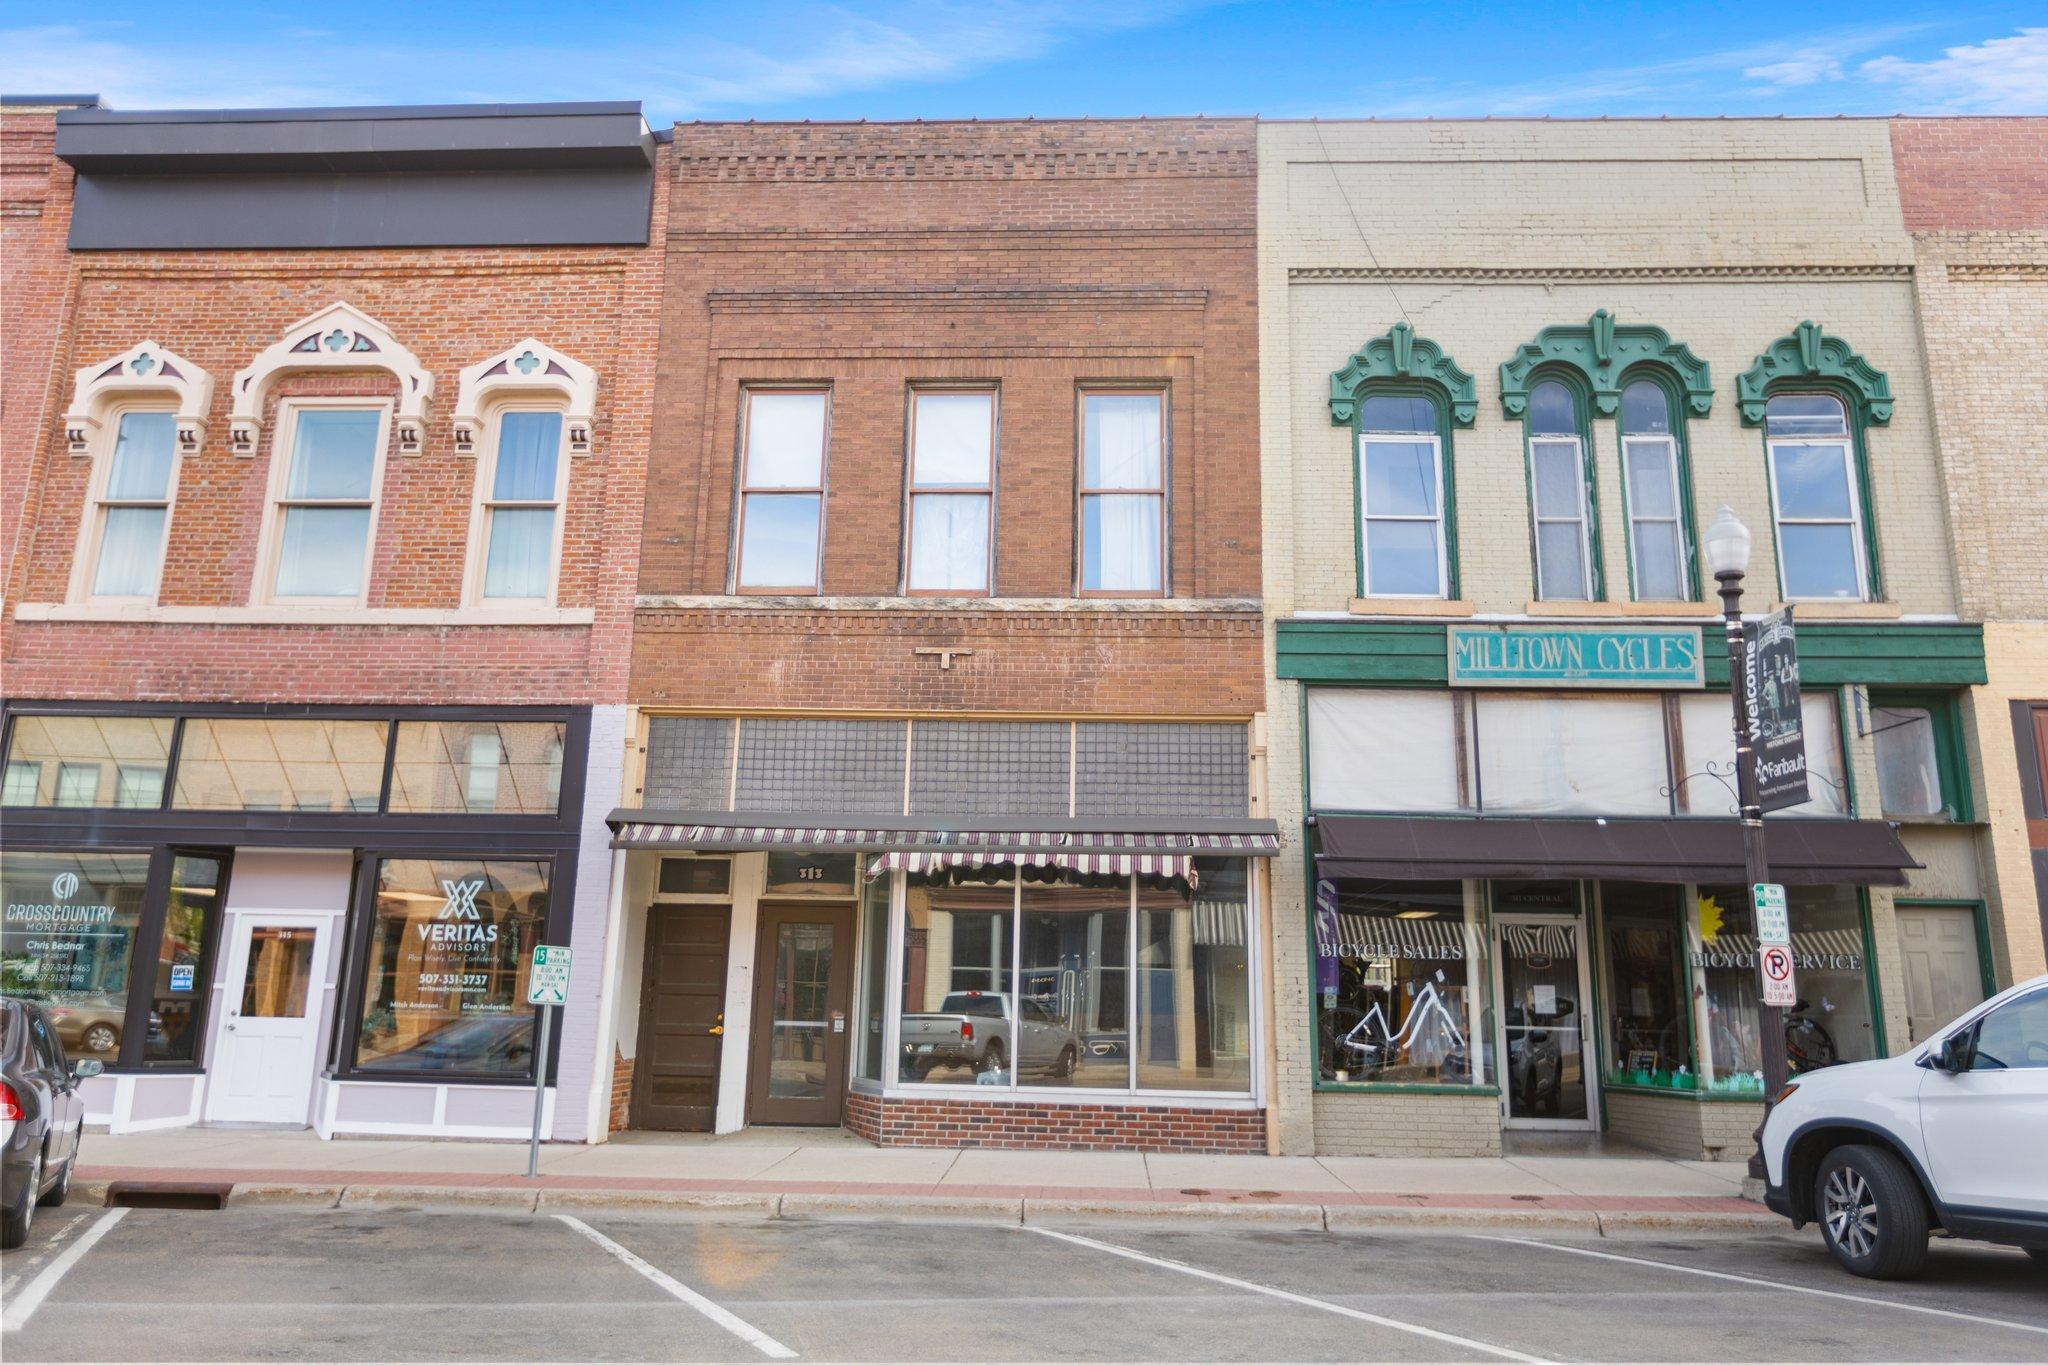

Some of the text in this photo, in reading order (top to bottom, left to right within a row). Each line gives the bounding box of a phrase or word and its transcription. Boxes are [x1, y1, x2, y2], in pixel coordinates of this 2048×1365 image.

[1456, 635, 1696, 671] MILLTOWN CYCLES
[1746, 640, 1761, 742] Welcome
[1768, 752, 1806, 778] Faribault
[799, 866, 824, 880] 313
[1523, 895, 1563, 903] CENTRAL
[7, 904, 116, 922] CROSSCOUNTRY
[26, 922, 91, 932] MORTGAGE
[418, 924, 498, 942] VERITAS
[26, 941, 86, 951] Chris Bednar
[430, 943, 486, 952] ADVISORS
[1320, 943, 1462, 960] BICYCLE SALES
[536, 950, 546, 962] 15
[1791, 953, 1861, 971] ERVICE
[173, 967, 193, 977] OPEN
[419, 973, 488, 985] 507-331-3737
[409, 1001, 439, 1009] Anderson
[462, 1002, 511, 1011] Glen Anderson
